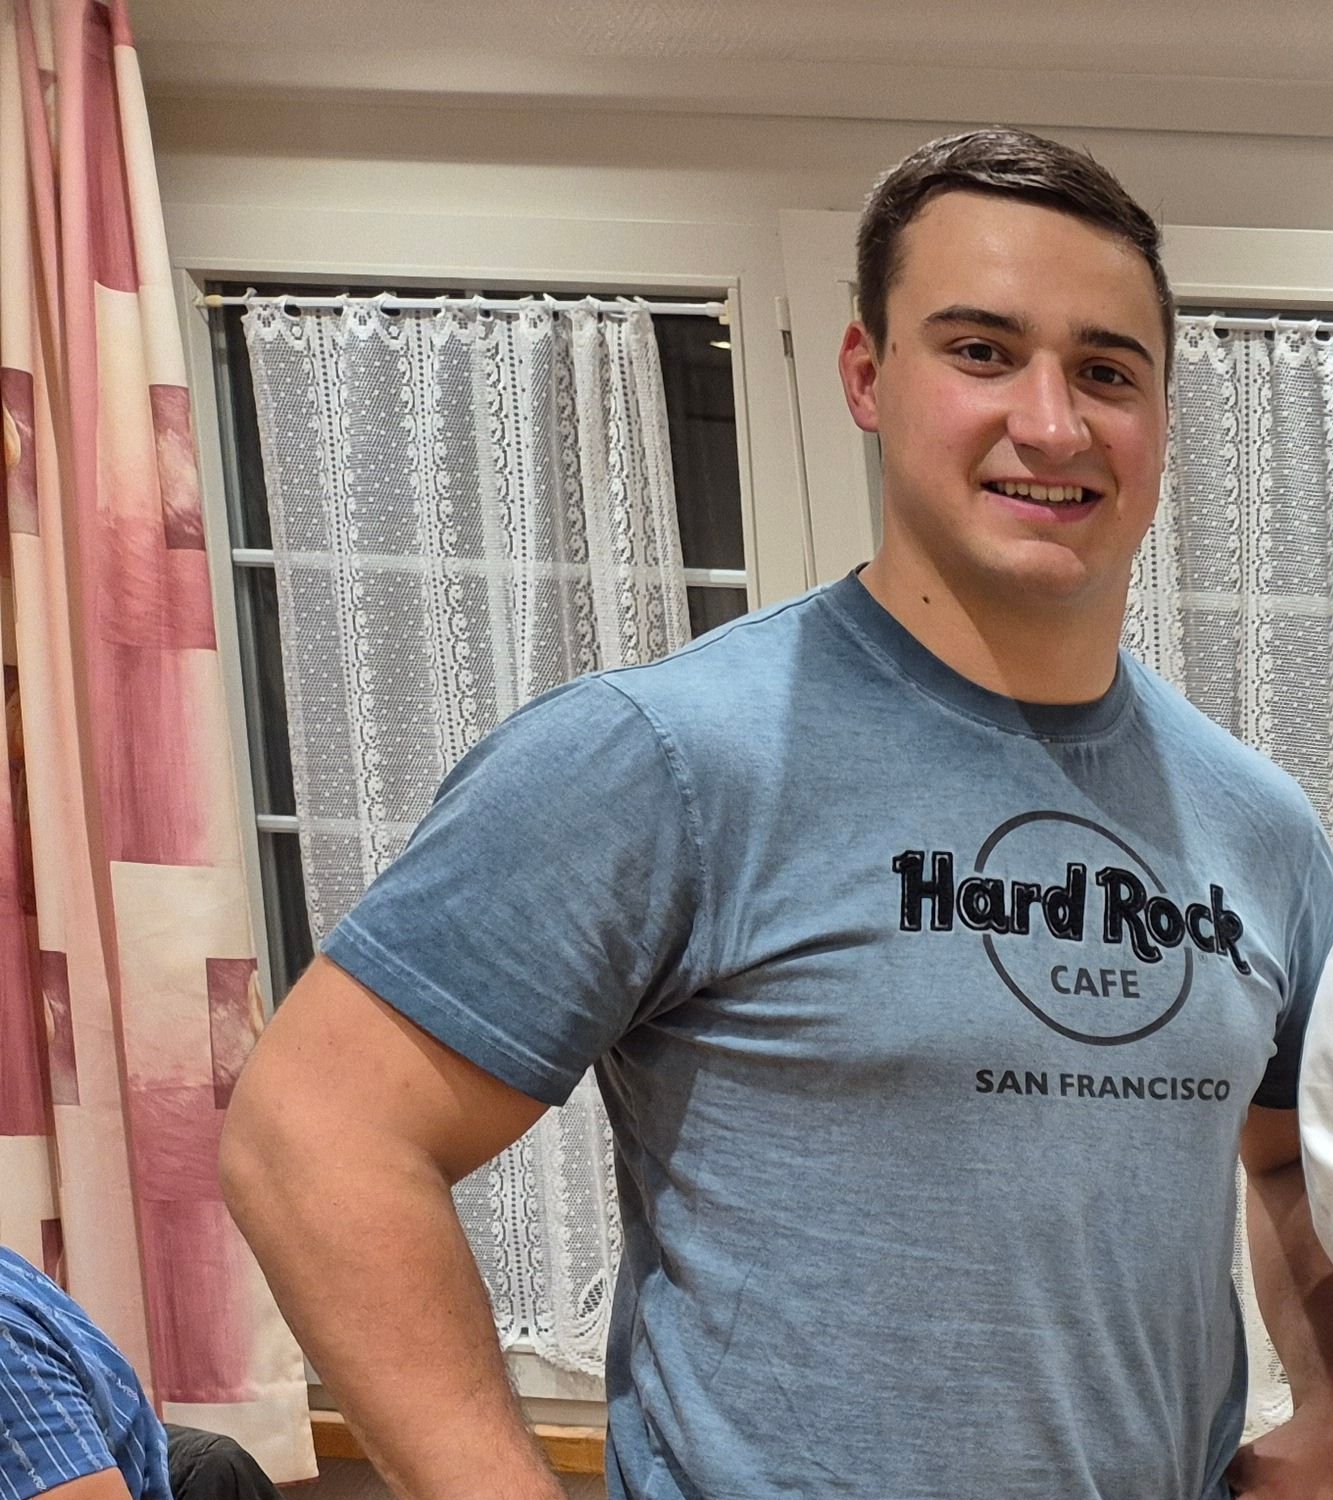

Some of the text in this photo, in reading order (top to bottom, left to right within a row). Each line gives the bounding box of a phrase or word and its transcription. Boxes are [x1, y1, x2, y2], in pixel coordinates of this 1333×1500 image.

[892, 849, 1251, 975] Hard Rock
[1050, 965, 1141, 999] CAFE
[975, 1069, 1230, 1101] SAN FRANCISCO
